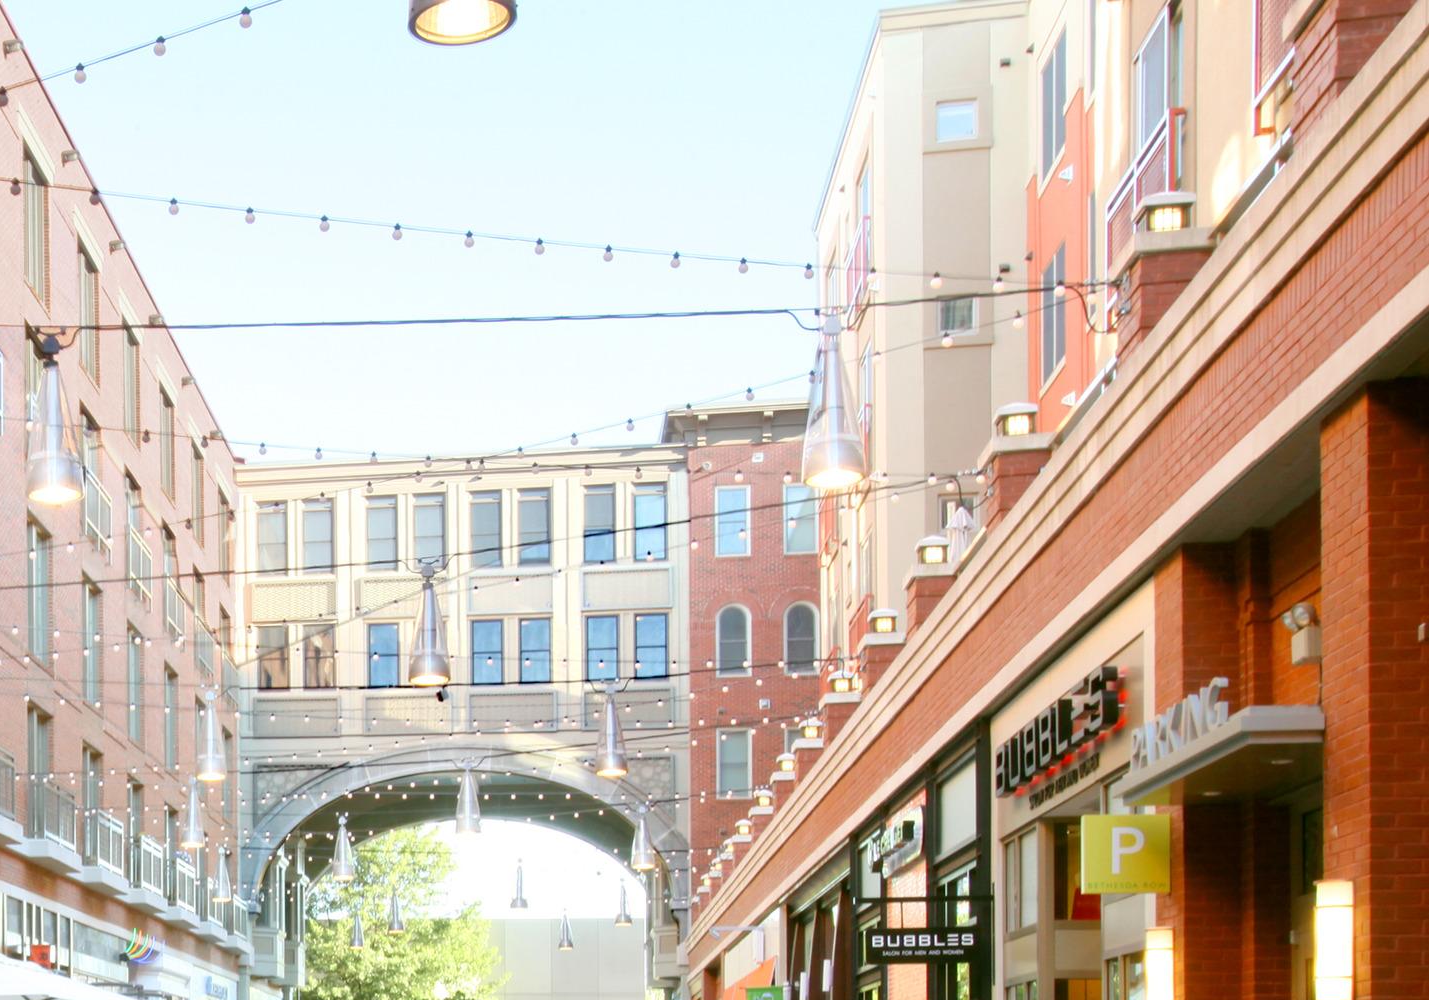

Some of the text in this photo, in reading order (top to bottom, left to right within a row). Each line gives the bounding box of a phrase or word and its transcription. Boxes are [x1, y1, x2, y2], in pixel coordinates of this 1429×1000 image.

[996, 666, 1118, 797] BUBBLES
[1129, 677, 1229, 772] PARKING
[1111, 826, 1145, 875] P
[872, 933, 974, 948] BUBBLES
